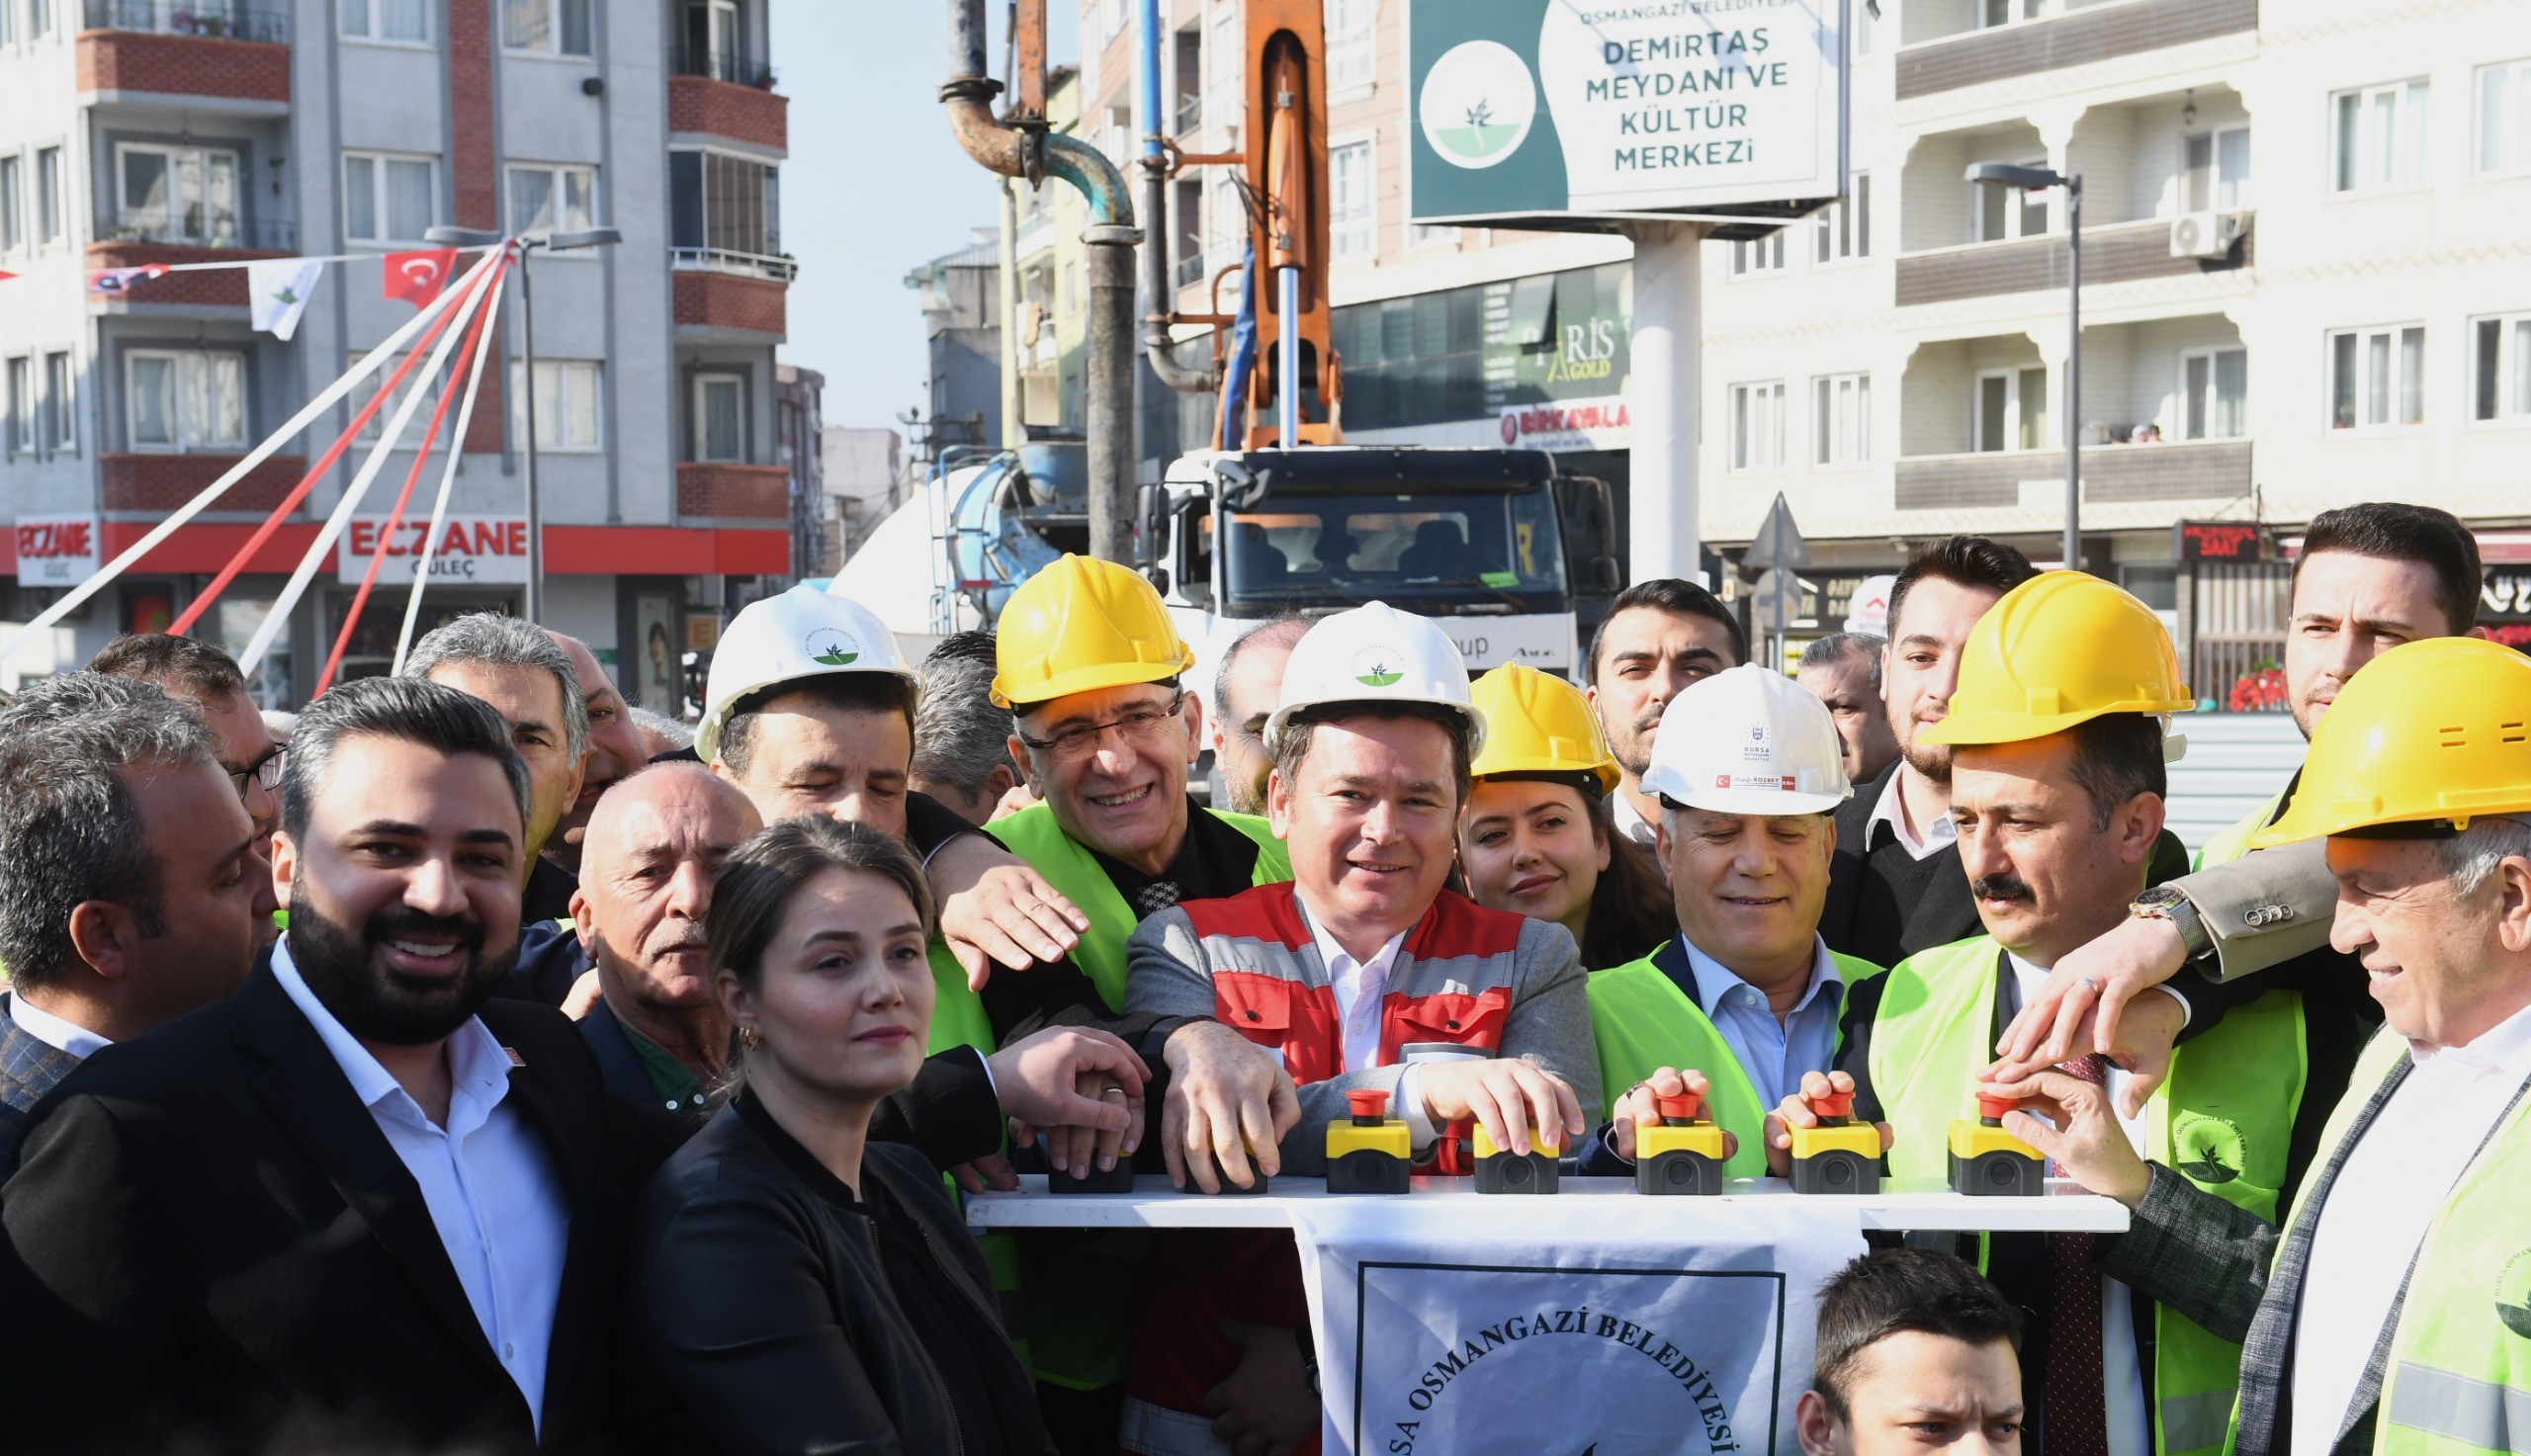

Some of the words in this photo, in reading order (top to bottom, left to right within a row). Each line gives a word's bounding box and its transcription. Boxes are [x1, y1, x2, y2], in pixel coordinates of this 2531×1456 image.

[1604, 28, 1769, 65] DEMİRTAŞ
[1586, 67, 1734, 102] MEYDANI
[1747, 62, 1789, 88] VE
[1620, 100, 1748, 135] KÜLTÜR
[1615, 138, 1753, 171] MERKEZİ
[1569, 359, 1612, 381] GOLD
[351, 521, 527, 556] ECZANE
[1451, 637, 1488, 659] up
[1408, 1306, 1588, 1412] OSMANGAZİ
[1594, 1314, 1740, 1455] BELEDİYESİ
